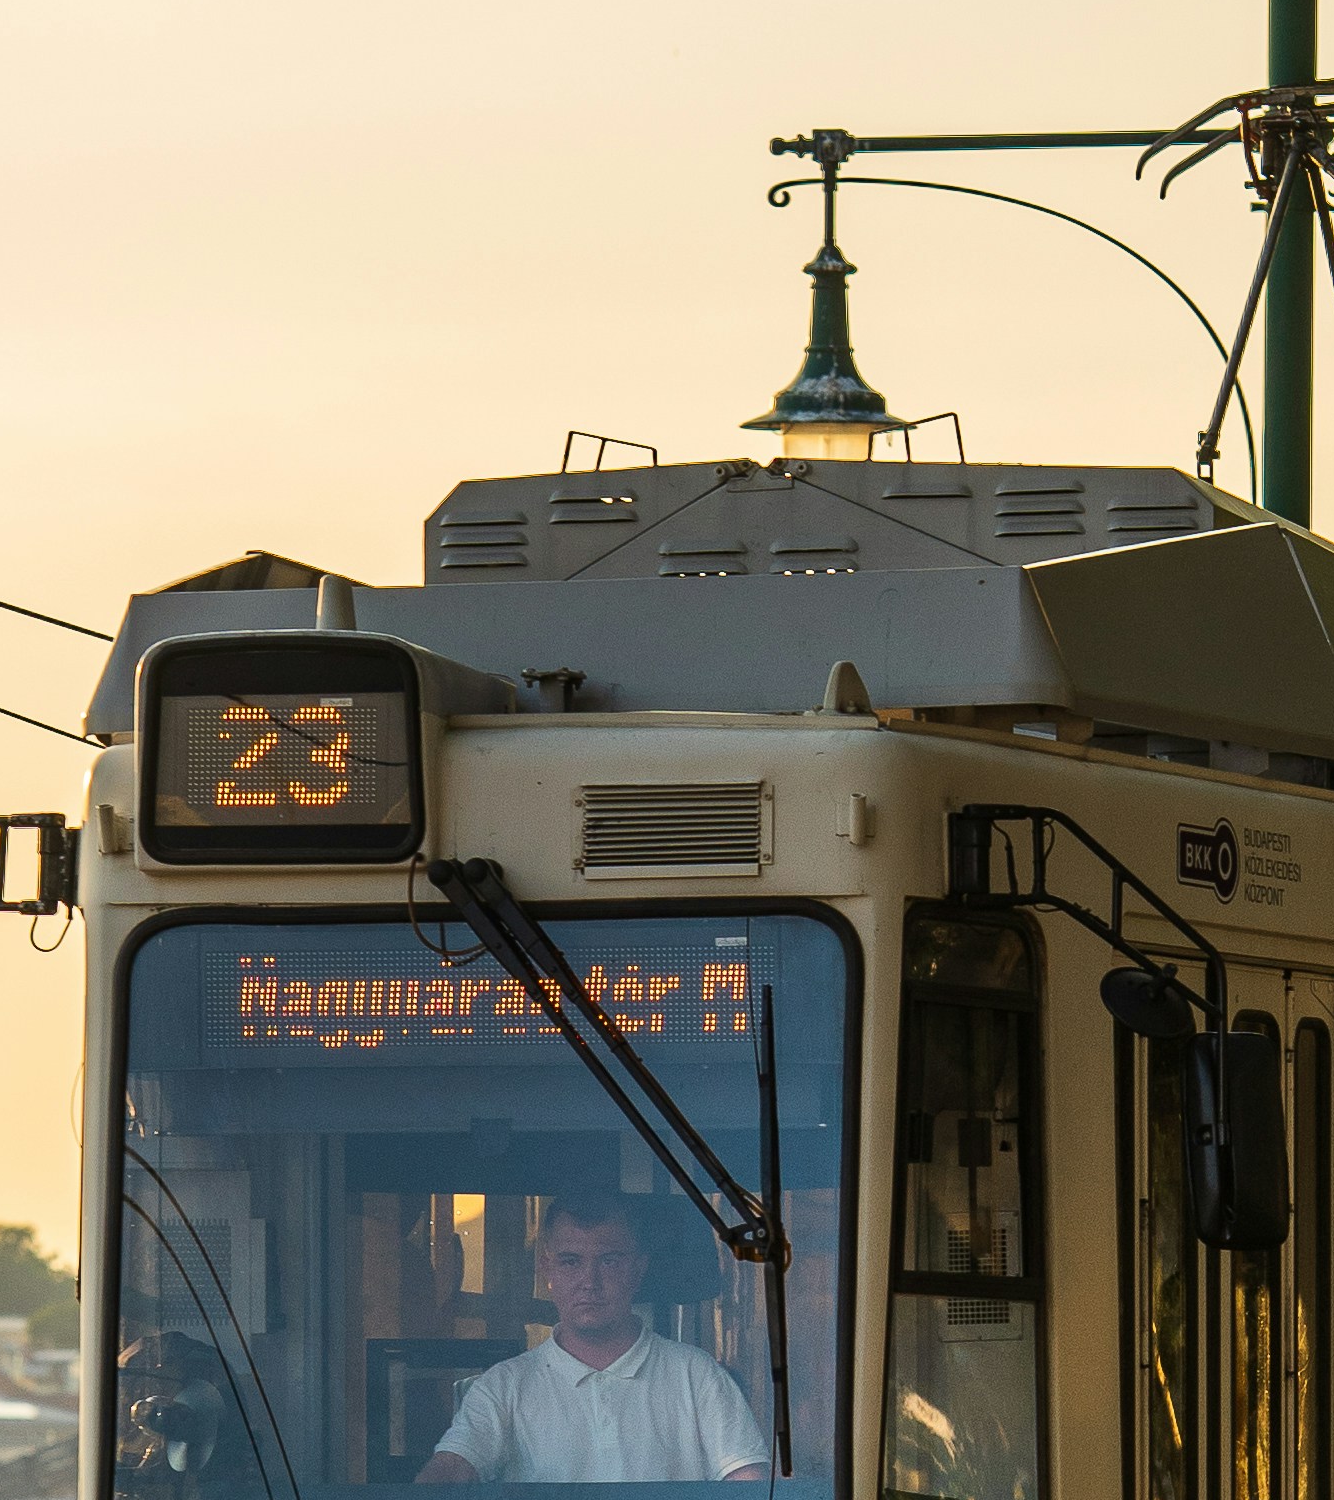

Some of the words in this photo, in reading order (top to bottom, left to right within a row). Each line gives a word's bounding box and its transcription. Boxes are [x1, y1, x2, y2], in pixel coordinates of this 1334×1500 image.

[216, 706, 349, 806] 23
[1244, 828, 1291, 854] BUDAPESTI
[1185, 842, 1212, 871] BKK
[1244, 852, 1302, 882] KÖZLEKEDÉSI
[1244, 880, 1285, 907] KÖZPONT
[703, 963, 747, 1032] M
